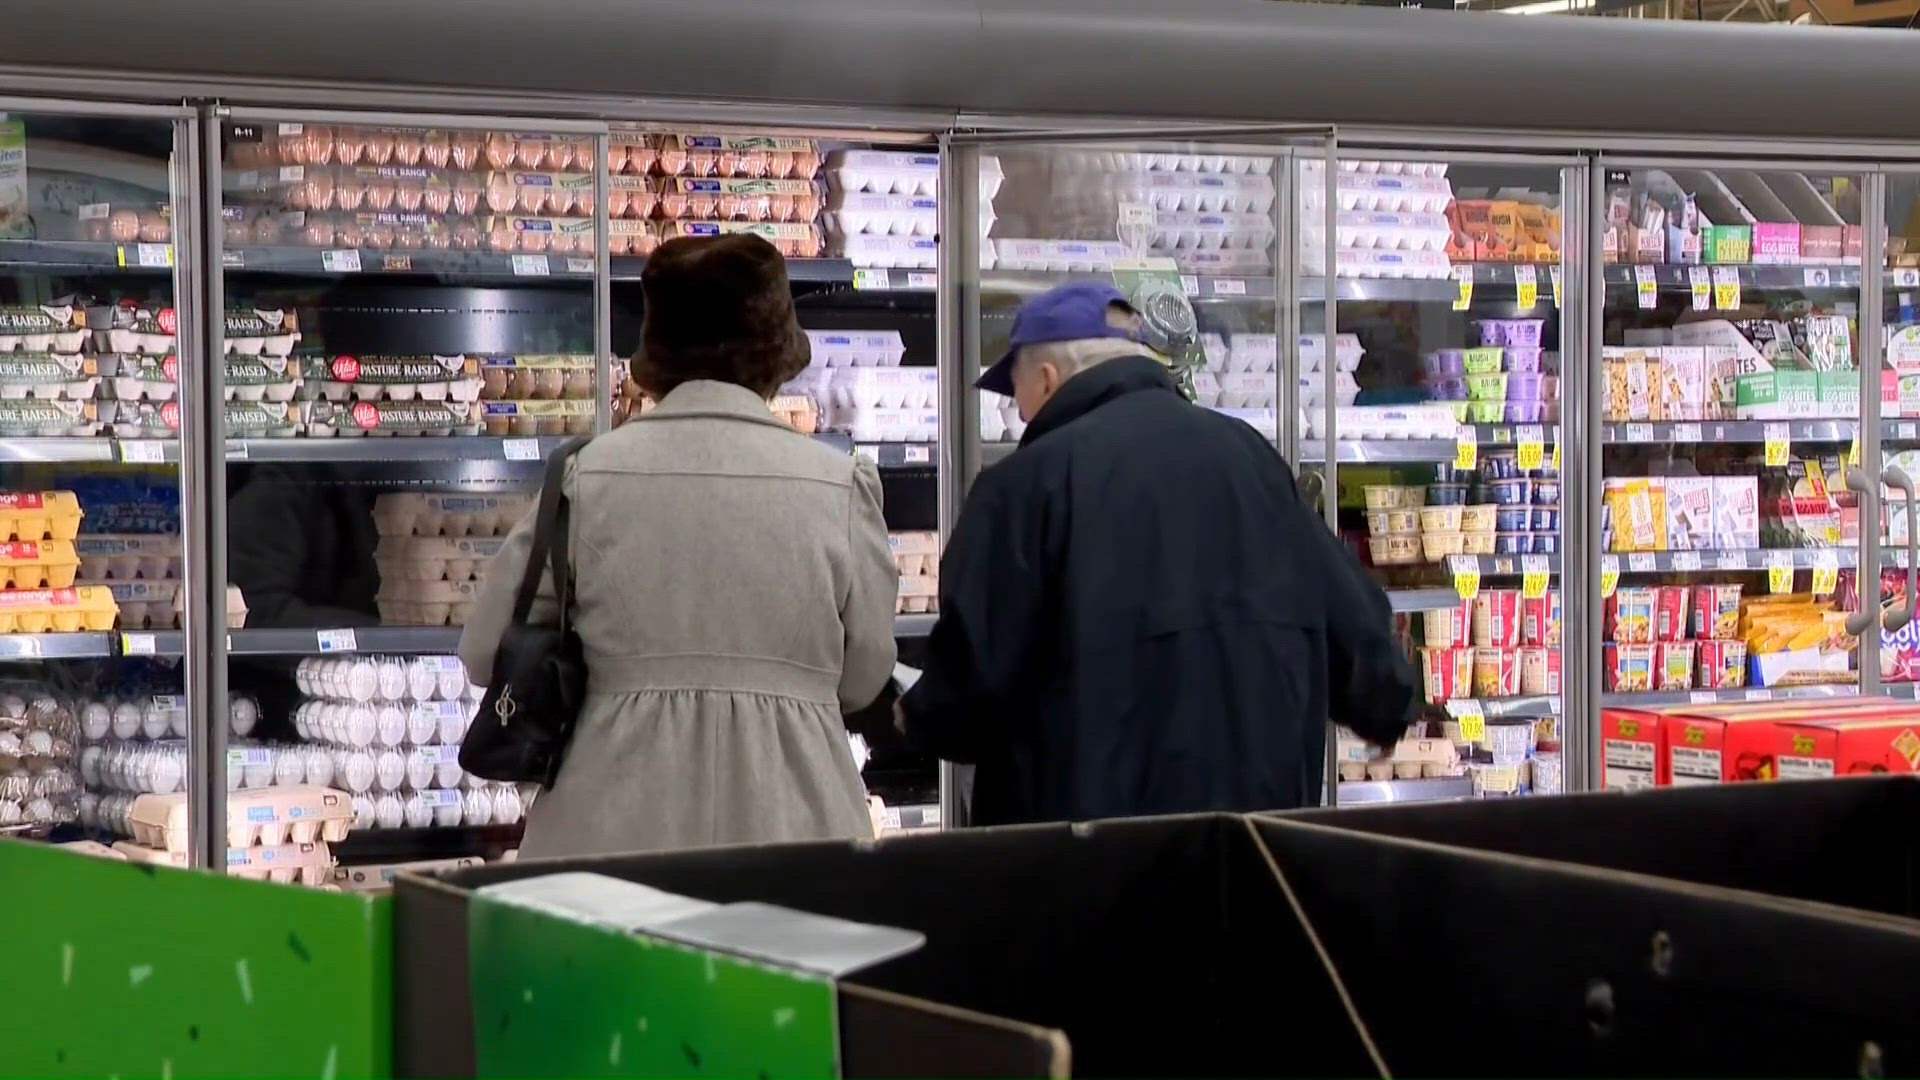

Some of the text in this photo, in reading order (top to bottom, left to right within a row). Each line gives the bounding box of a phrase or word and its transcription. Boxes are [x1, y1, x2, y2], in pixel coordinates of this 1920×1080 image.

[234, 127, 253, 137] R-11
[378, 167, 427, 177] FREE RANGE
[378, 213, 428, 223] FREE RANGE
[1761, 243, 1777, 253] EGG
[1778, 243, 1798, 253] BITES
